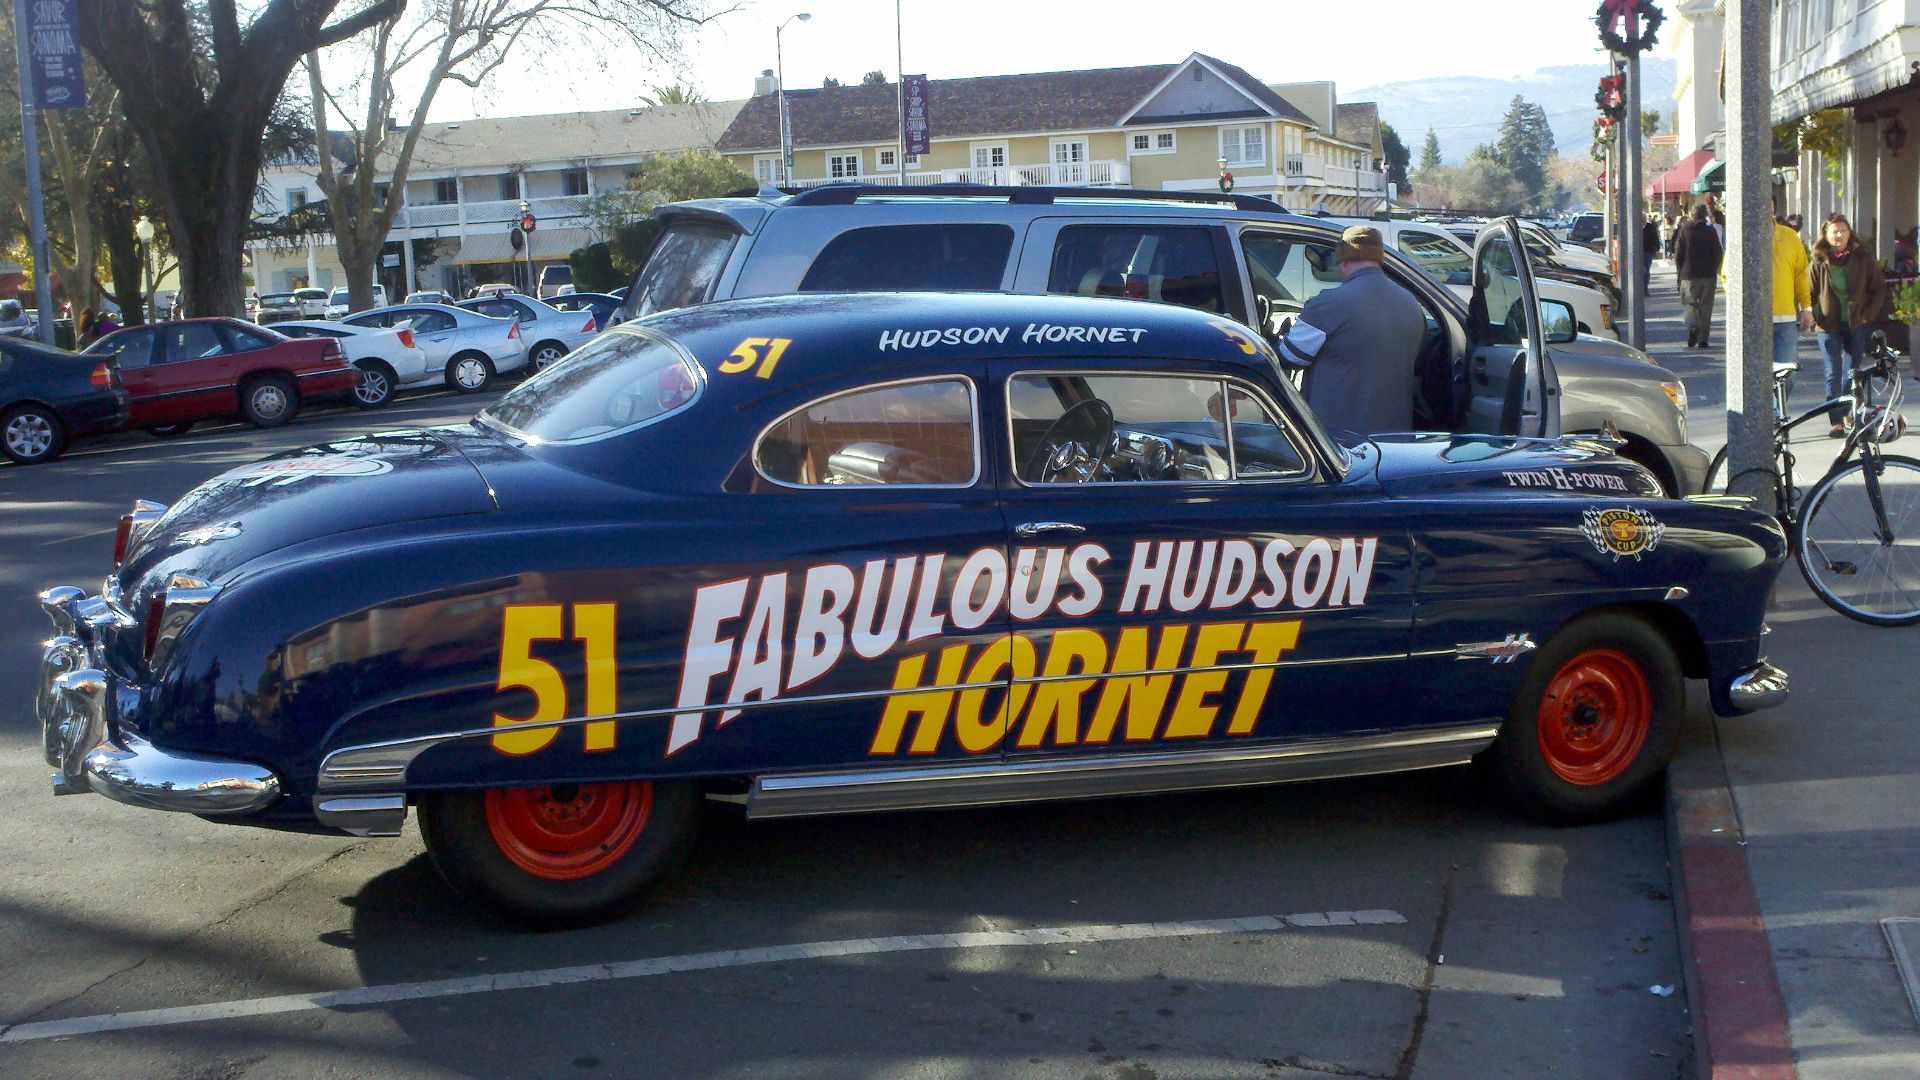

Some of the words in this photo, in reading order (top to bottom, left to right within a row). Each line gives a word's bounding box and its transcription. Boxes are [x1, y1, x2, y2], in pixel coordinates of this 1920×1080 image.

[879, 327, 1010, 352] HUDSON
[1022, 323, 1148, 345] HORNET
[717, 337, 793, 380] 51
[1502, 471, 1551, 487] TWIN
[1601, 511, 1640, 526] PISTON
[1616, 541, 1637, 551] CUP
[665, 543, 1112, 758] FABULOUS
[1118, 537, 1378, 615] HUDSON
[490, 601, 618, 758] 51
[868, 620, 1303, 756] HORNET
